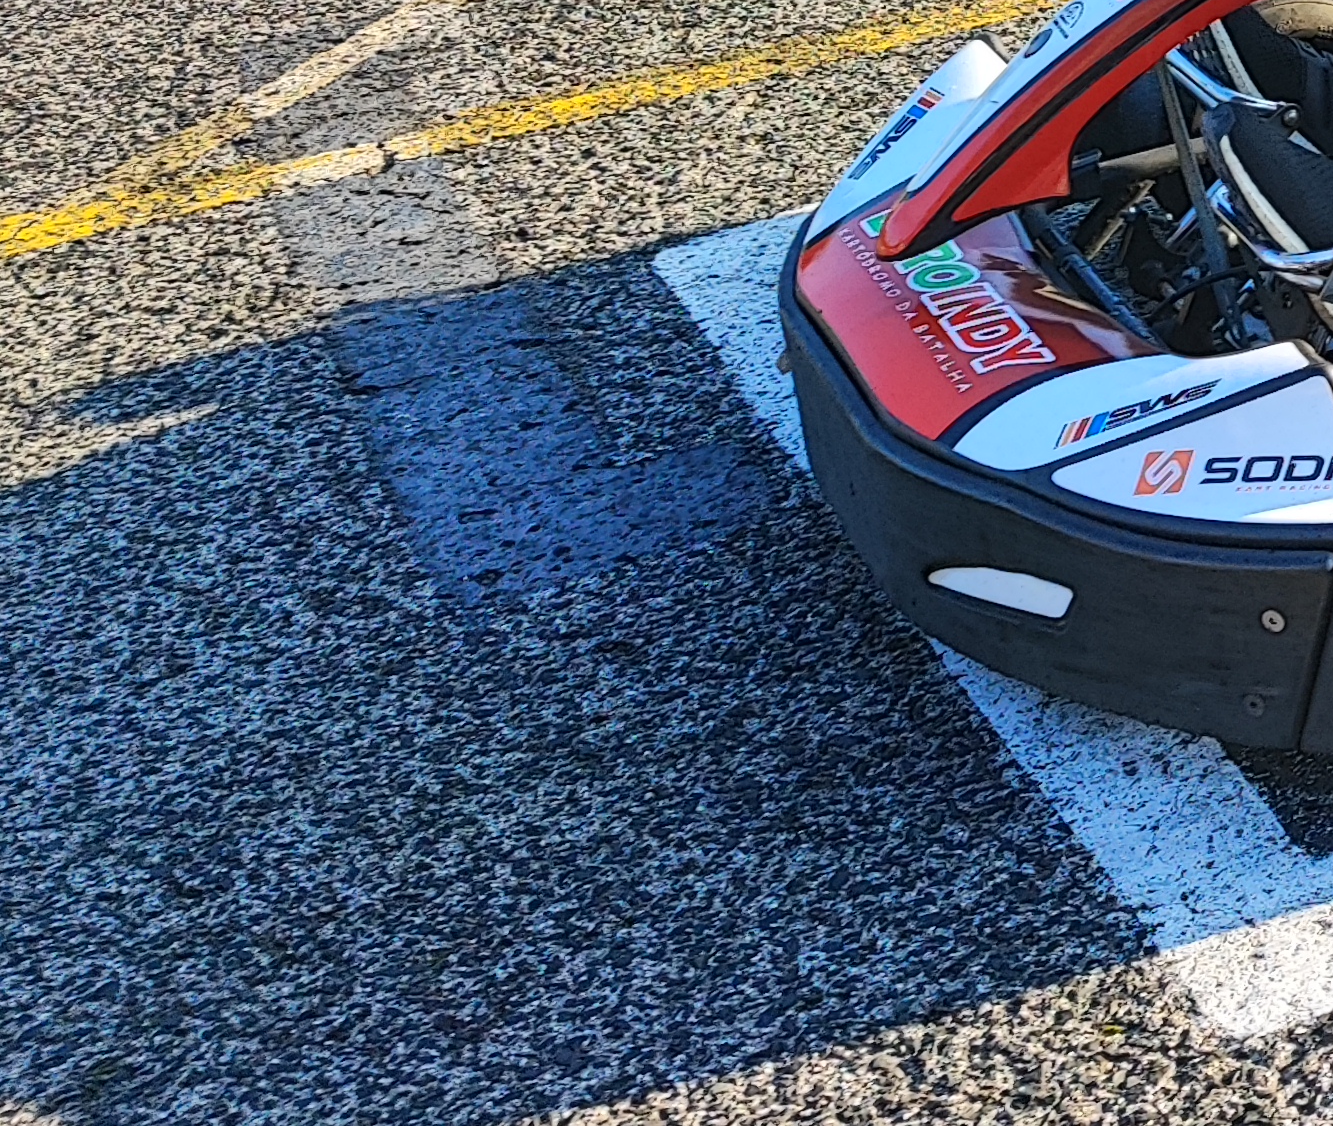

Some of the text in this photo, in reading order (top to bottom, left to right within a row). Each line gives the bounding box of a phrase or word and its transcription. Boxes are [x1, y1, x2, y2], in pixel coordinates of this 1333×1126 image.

[837, 227, 973, 394] KARTÓDROMO DA BATALHA
